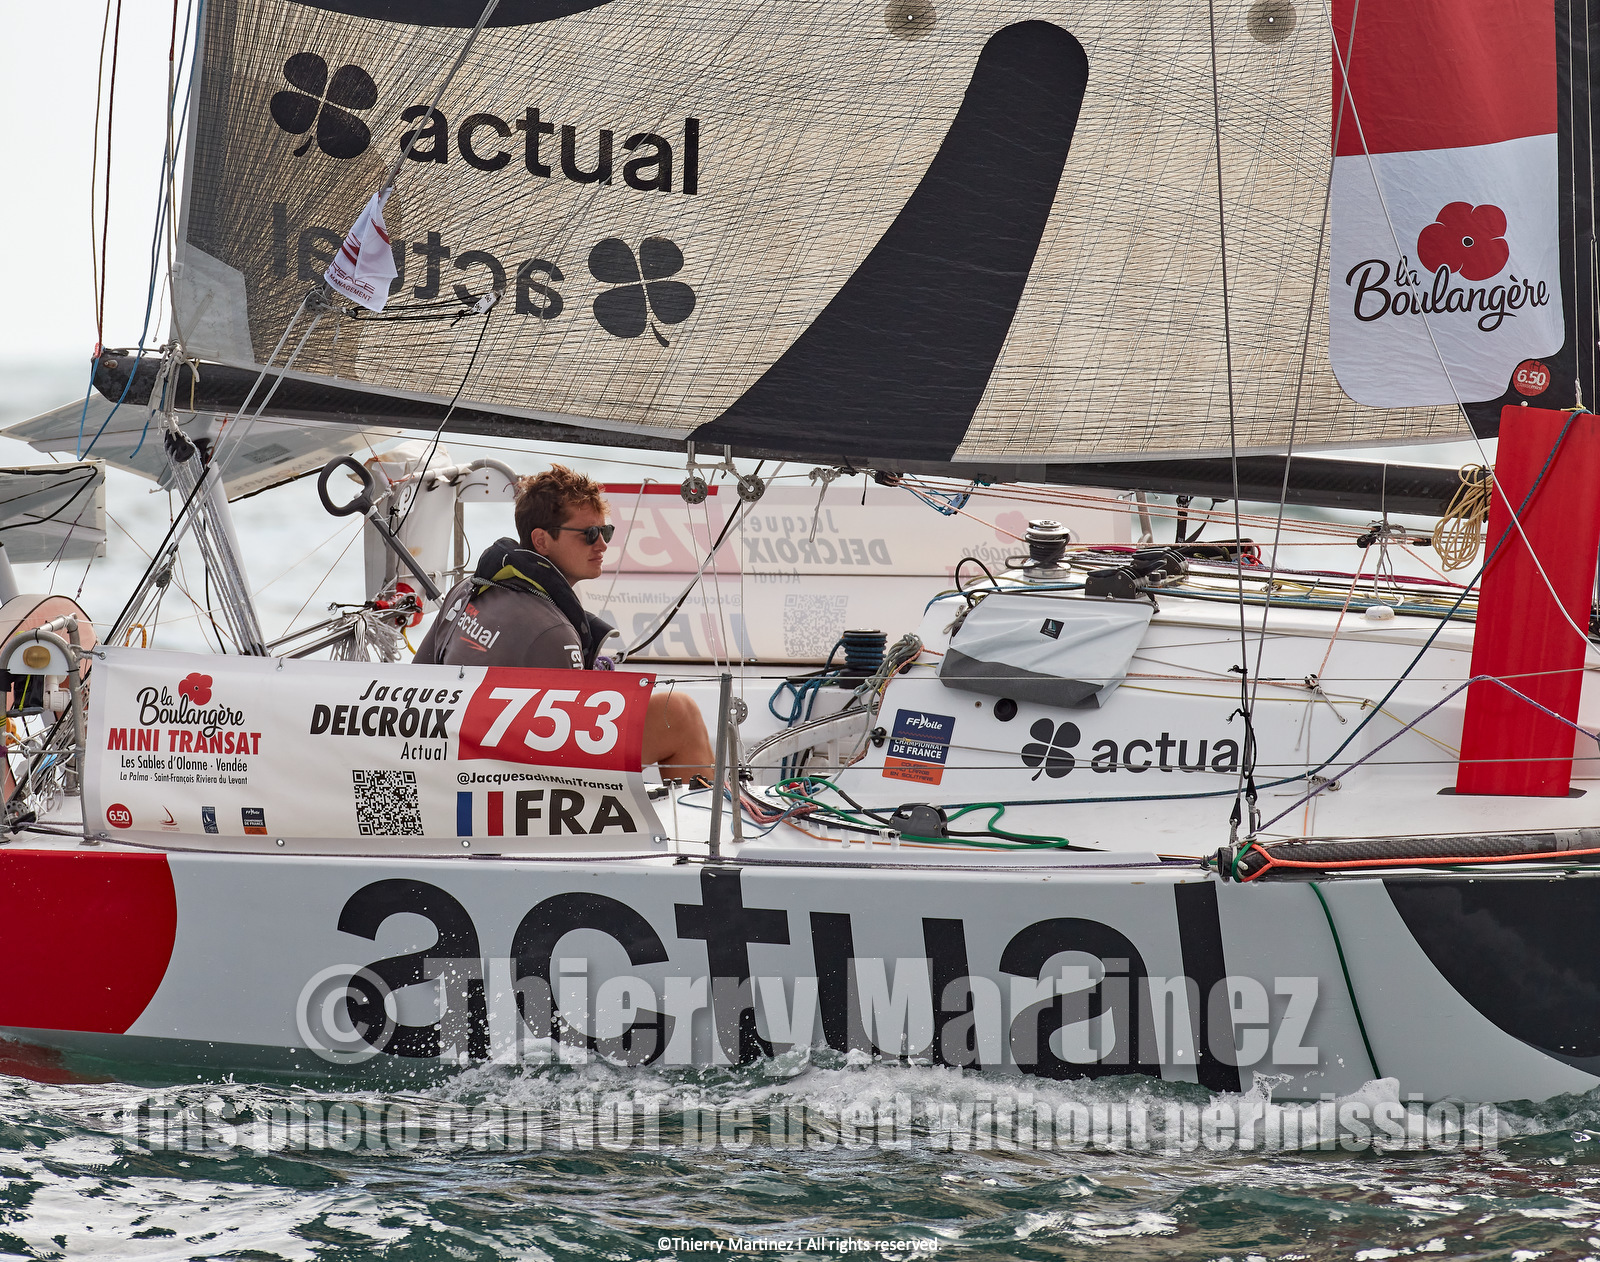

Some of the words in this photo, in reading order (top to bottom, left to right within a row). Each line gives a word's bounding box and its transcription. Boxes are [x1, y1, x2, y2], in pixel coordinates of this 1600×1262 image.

[400, 104, 699, 195] actual
[1394, 256, 1421, 287] la
[329, 274, 372, 301] MANAGEMENT
[1346, 259, 1550, 332] Boulangère
[1516, 370, 1546, 386] 6.50
[458, 612, 500, 649] actual
[160, 686, 174, 706] la
[359, 680, 463, 709] Jacques
[136, 687, 245, 738] Boulangère
[310, 704, 454, 739] DELCROIX
[479, 687, 626, 755] 753
[107, 728, 160, 752] MINI
[167, 730, 261, 755] TRANSAT
[401, 741, 447, 761] Actual
[892, 744, 905, 754] DE
[906, 746, 942, 759] FRANCE
[121, 755, 135, 769] Les
[138, 755, 165, 769] Sables
[216, 758, 248, 772] Vendée
[902, 773, 933, 781] SOLITAIRE
[120, 772, 127, 781] La
[129, 772, 148, 782] Palma
[154, 773, 194, 784] Saint-François
[196, 774, 217, 784] Riviera
[219, 775, 226, 784] du
[228, 775, 248, 785] Levant
[457, 772, 624, 791] @JacquesaditMiniTransat
[109, 810, 130, 822] 6.50
[515, 789, 638, 836] FRA
[337, 867, 1241, 1092] actual
